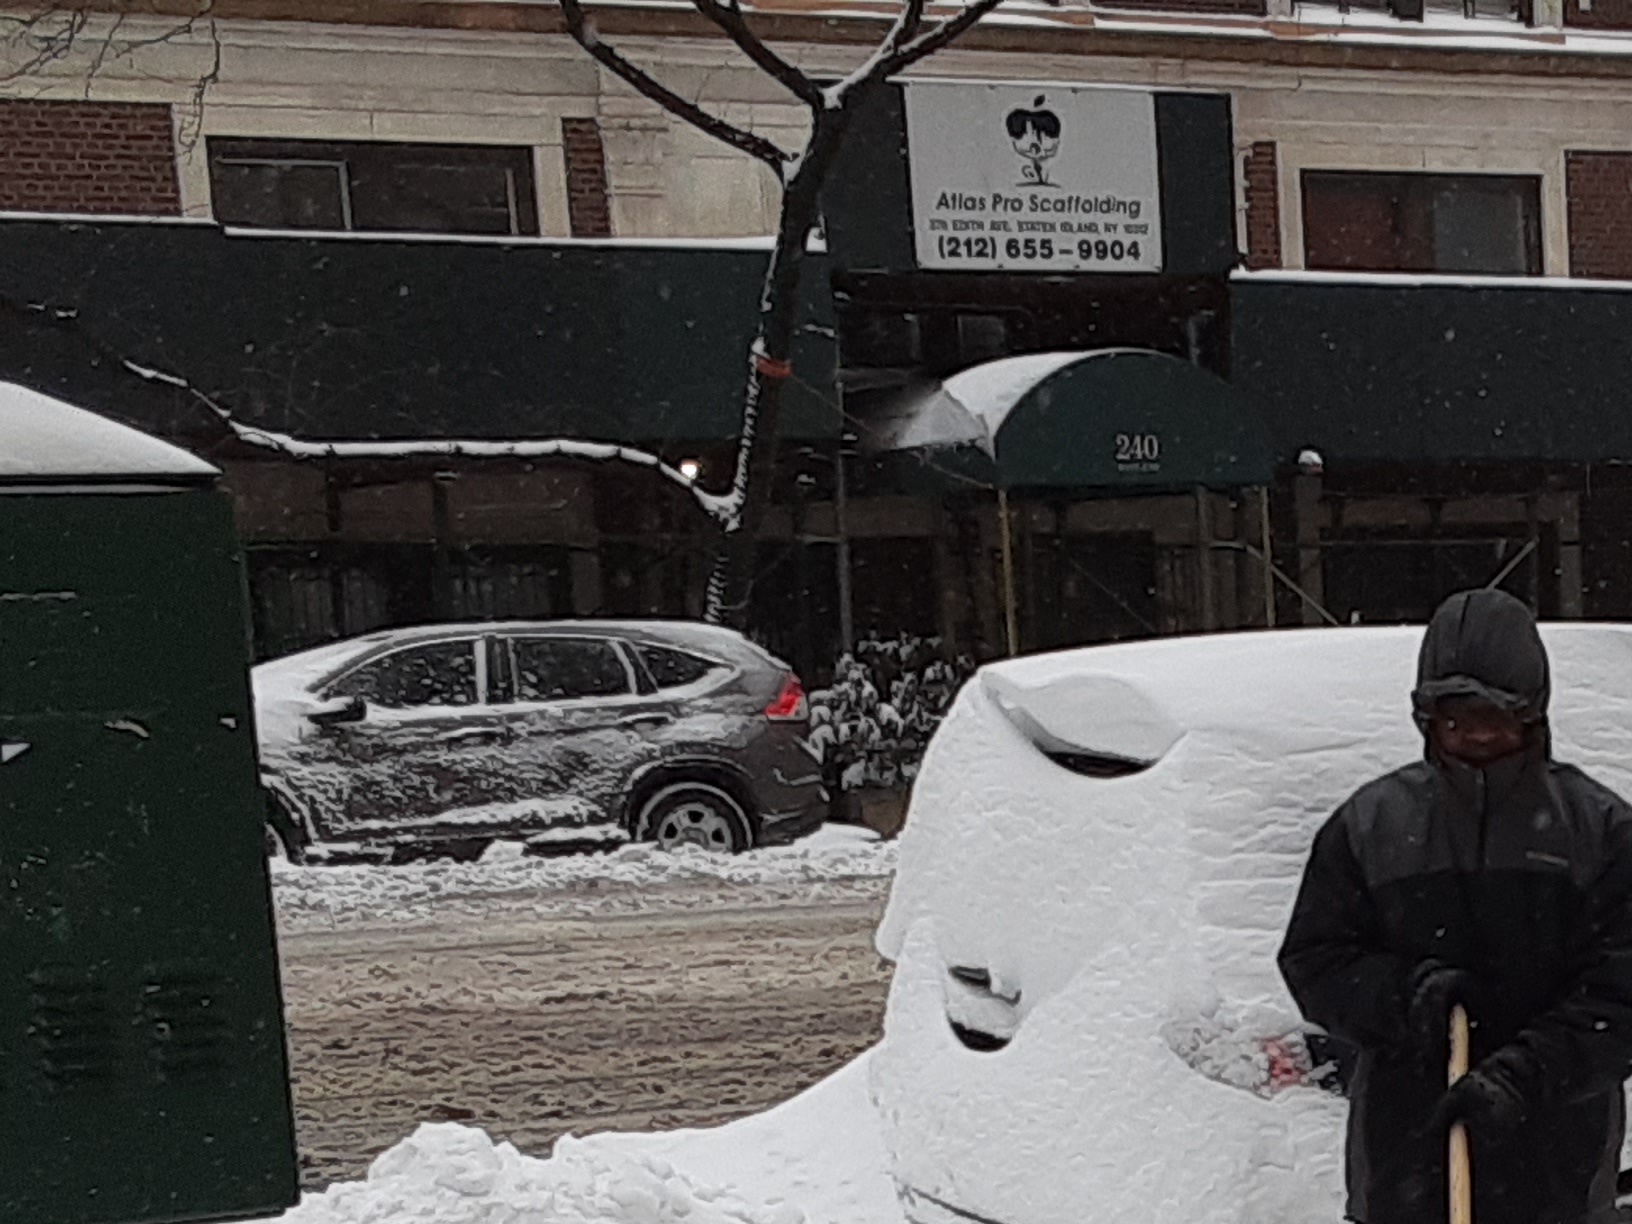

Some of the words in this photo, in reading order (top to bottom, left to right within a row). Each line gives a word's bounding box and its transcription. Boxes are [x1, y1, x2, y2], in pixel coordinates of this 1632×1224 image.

[936, 192, 986, 211] Atlas
[992, 193, 1023, 213] Pro
[1029, 194, 1141, 219] Scaffolding
[938, 235, 997, 259] (212)
[1115, 433, 1159, 460] 240
